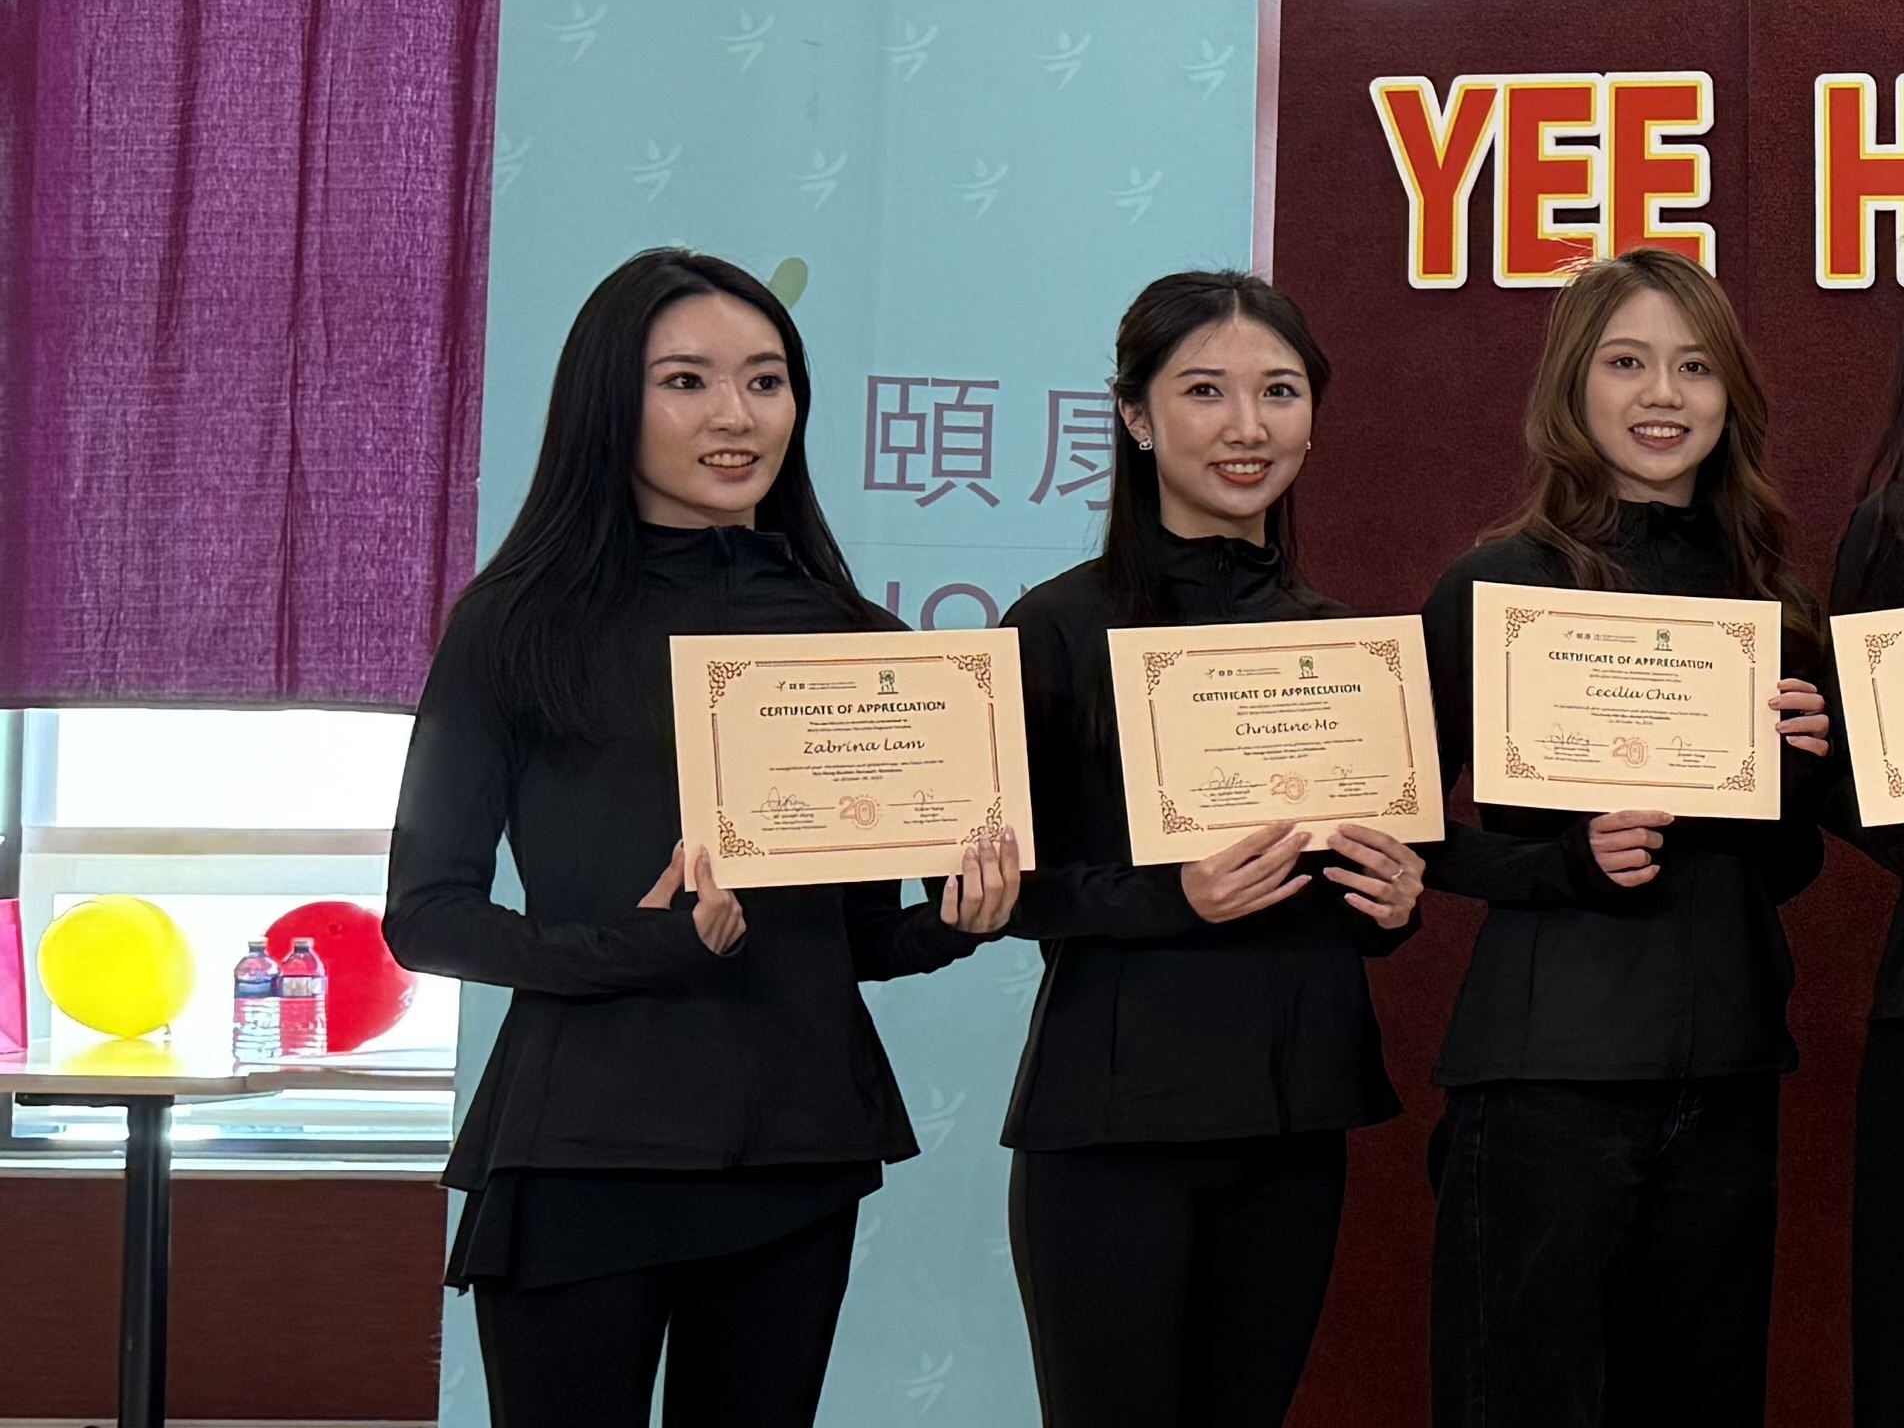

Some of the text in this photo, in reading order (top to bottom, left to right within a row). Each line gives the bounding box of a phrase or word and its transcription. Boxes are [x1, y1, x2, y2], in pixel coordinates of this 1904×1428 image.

[1370, 72, 1715, 289] YEE
[1548, 651, 1713, 670] CERTIFICATE OF APPRECIATION
[1192, 683, 1361, 703] CERTIFICATE OF APPRECIATION
[1645, 688, 1692, 702] Chan
[760, 700, 946, 717] CERTIFICATE OF APPRECIATION
[1235, 719, 1312, 737] Christine
[803, 738, 926, 755] Zabrina Lam
